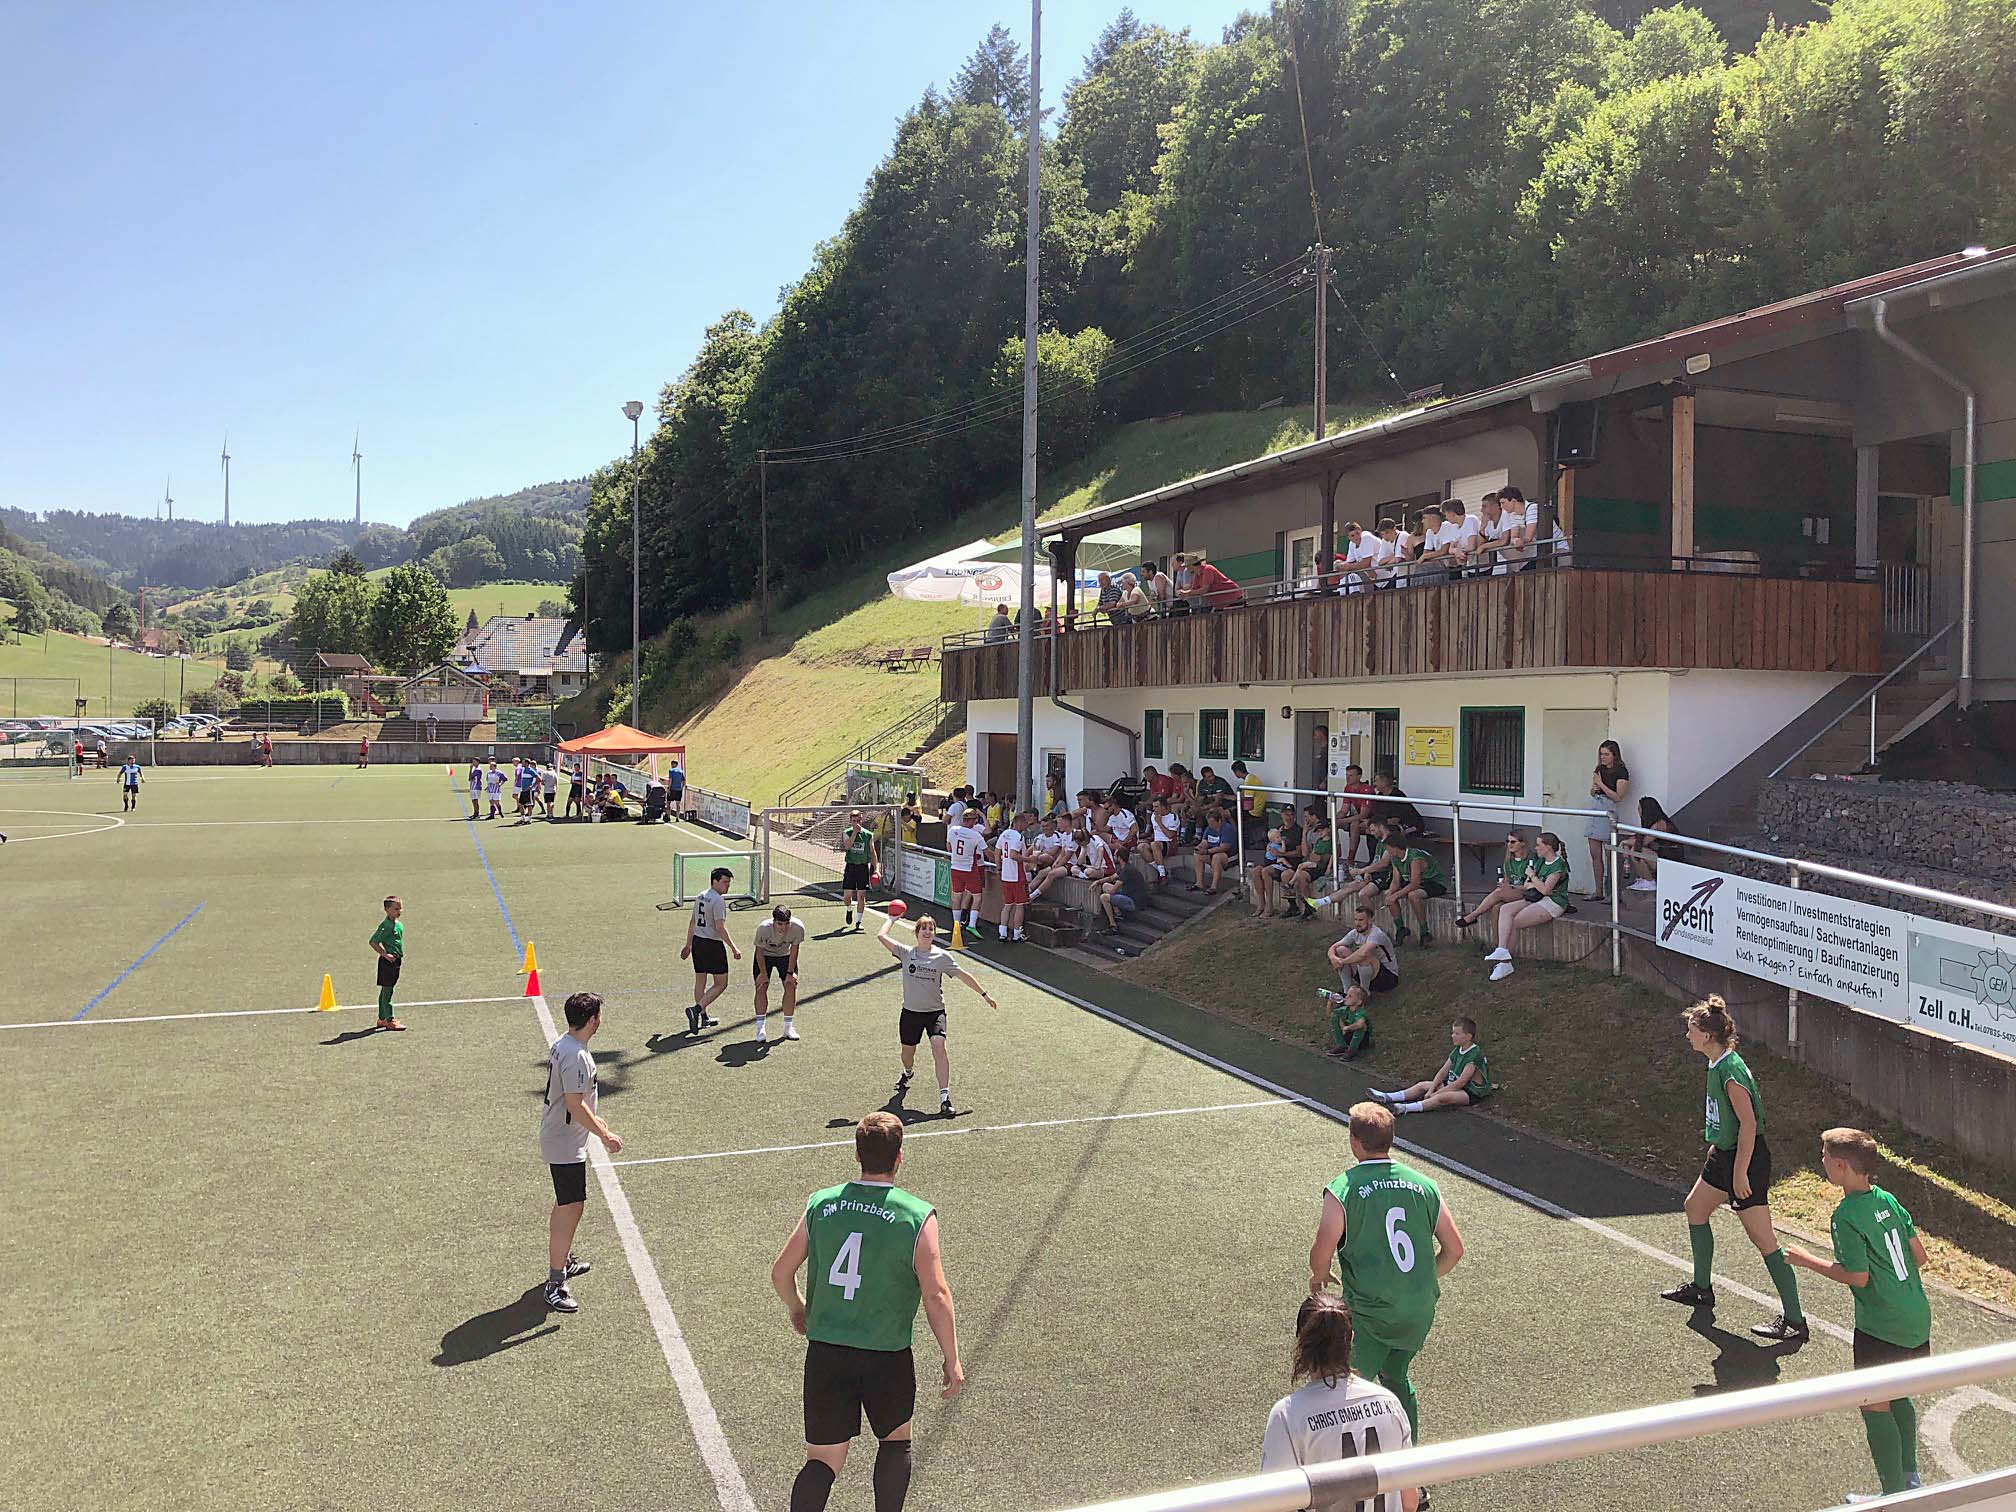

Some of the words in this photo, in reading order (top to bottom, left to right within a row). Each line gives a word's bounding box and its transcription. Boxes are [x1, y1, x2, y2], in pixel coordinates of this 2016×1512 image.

[956, 839, 965, 856] 6
[1003, 841, 1009, 858] 9
[697, 901, 707, 928] 5
[1663, 898, 1714, 934] ascent
[1736, 887, 1787, 912] Investitionen
[1788, 902, 1792, 913] /
[1794, 901, 1891, 938] Investmentstrategien
[1671, 928, 1714, 946] ondsspezialist
[1736, 906, 1809, 938] Vermögensaufbau
[1811, 925, 1815, 940] /
[1816, 927, 1898, 962] Sachwertanlagen
[1736, 925, 1813, 963] Rentenoptimierung
[1815, 947, 1819, 960] /
[1821, 949, 1900, 987] Baufinanzierung
[1736, 947, 1754, 963] Noch
[1798, 966, 1833, 987] Einfach
[1989, 976, 2008, 993] GEM
[1919, 996, 1943, 1020] Zell
[1948, 1008, 1974, 1030] a.H.
[1372, 1178, 1425, 1196] Prinzbach
[840, 1199, 896, 1224] Prinzbach
[1385, 1206, 1415, 1273] 6
[1884, 1228, 1909, 1282] 11
[828, 1231, 864, 1301] 4
[1307, 1410, 1339, 1432] CHRIST
[1338, 1405, 1363, 1423] GMBH
[1363, 1403, 1371, 1418] &
[1371, 1400, 1386, 1416] CO.
